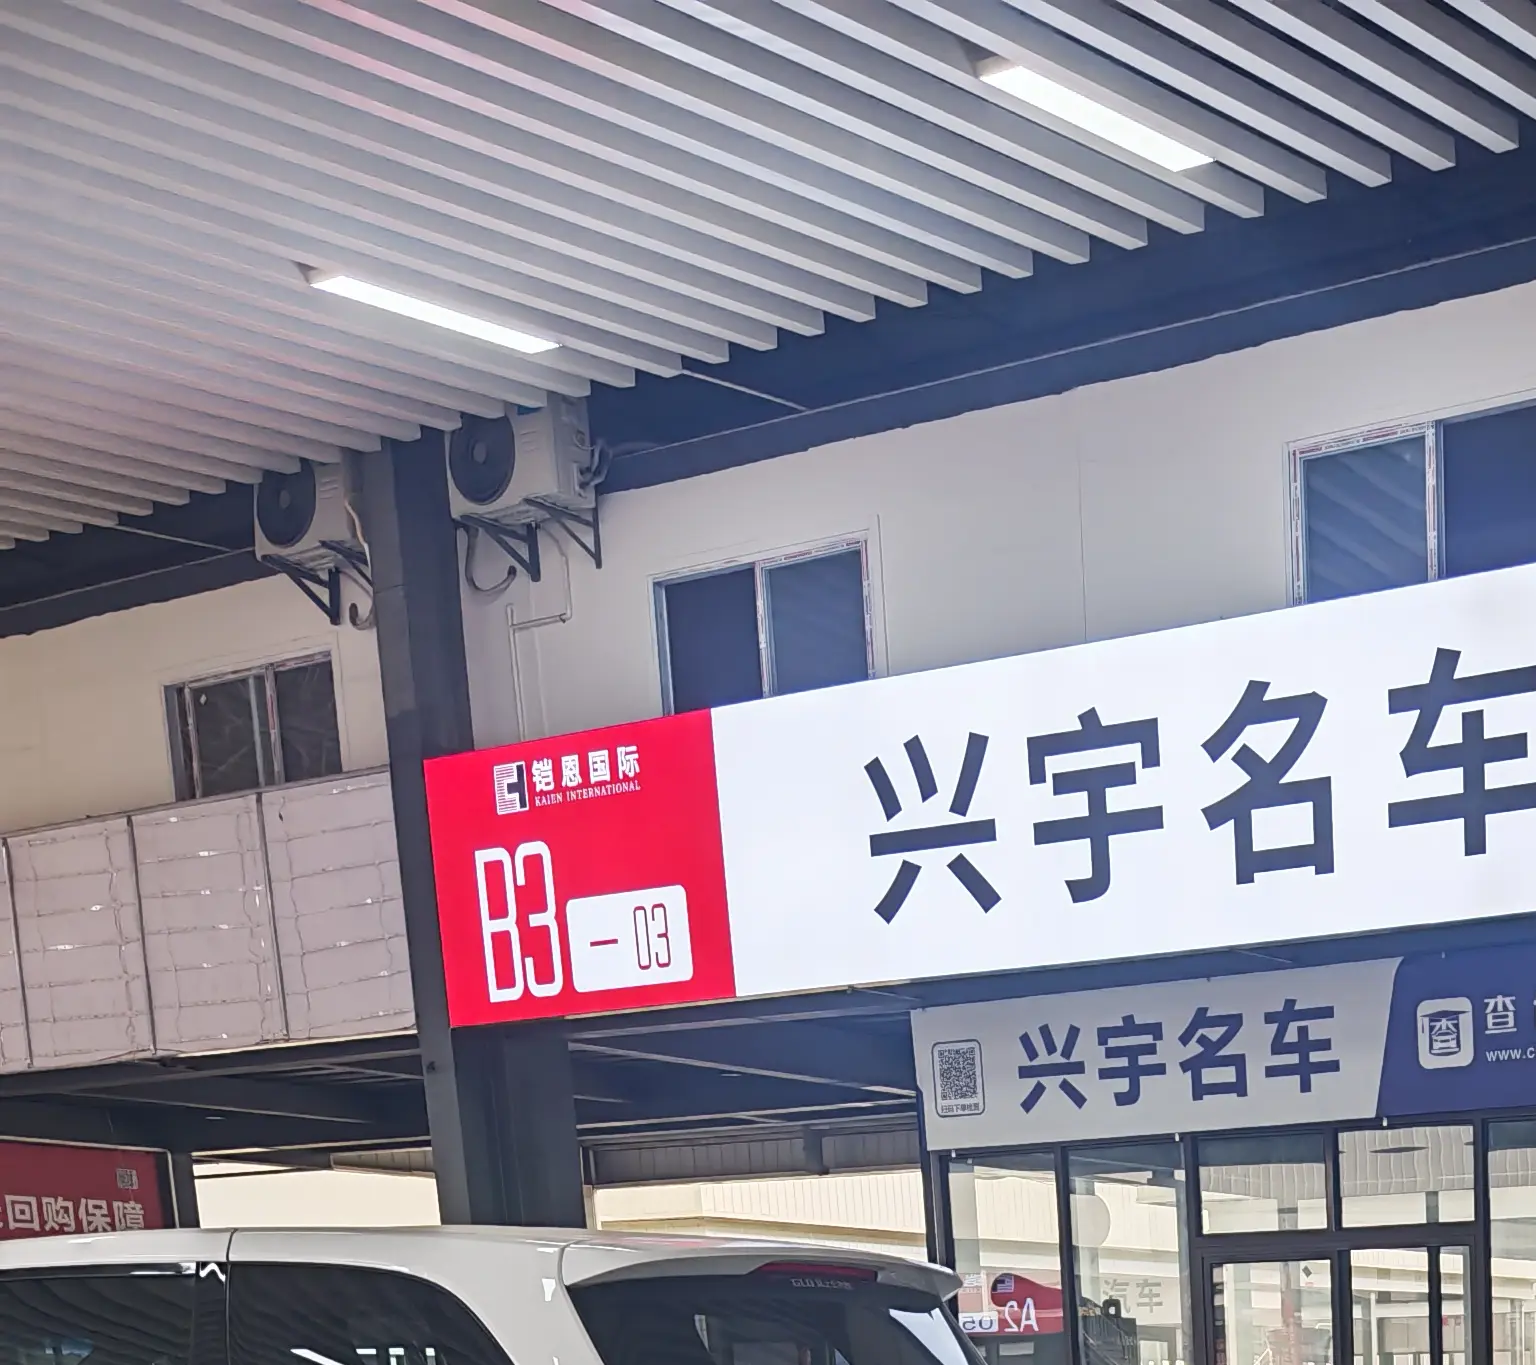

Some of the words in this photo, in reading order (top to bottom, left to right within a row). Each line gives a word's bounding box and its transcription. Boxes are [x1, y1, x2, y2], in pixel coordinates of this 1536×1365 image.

[532, 745, 640, 792] 铠恩国际
[535, 792, 563, 807] KAIEN
[567, 780, 641, 803] INTERNATIONAL
[475, 840, 563, 1003] B3
[1018, 998, 1340, 1114] 兴宇名车
[0, 1194, 145, 1232] 回购保障
